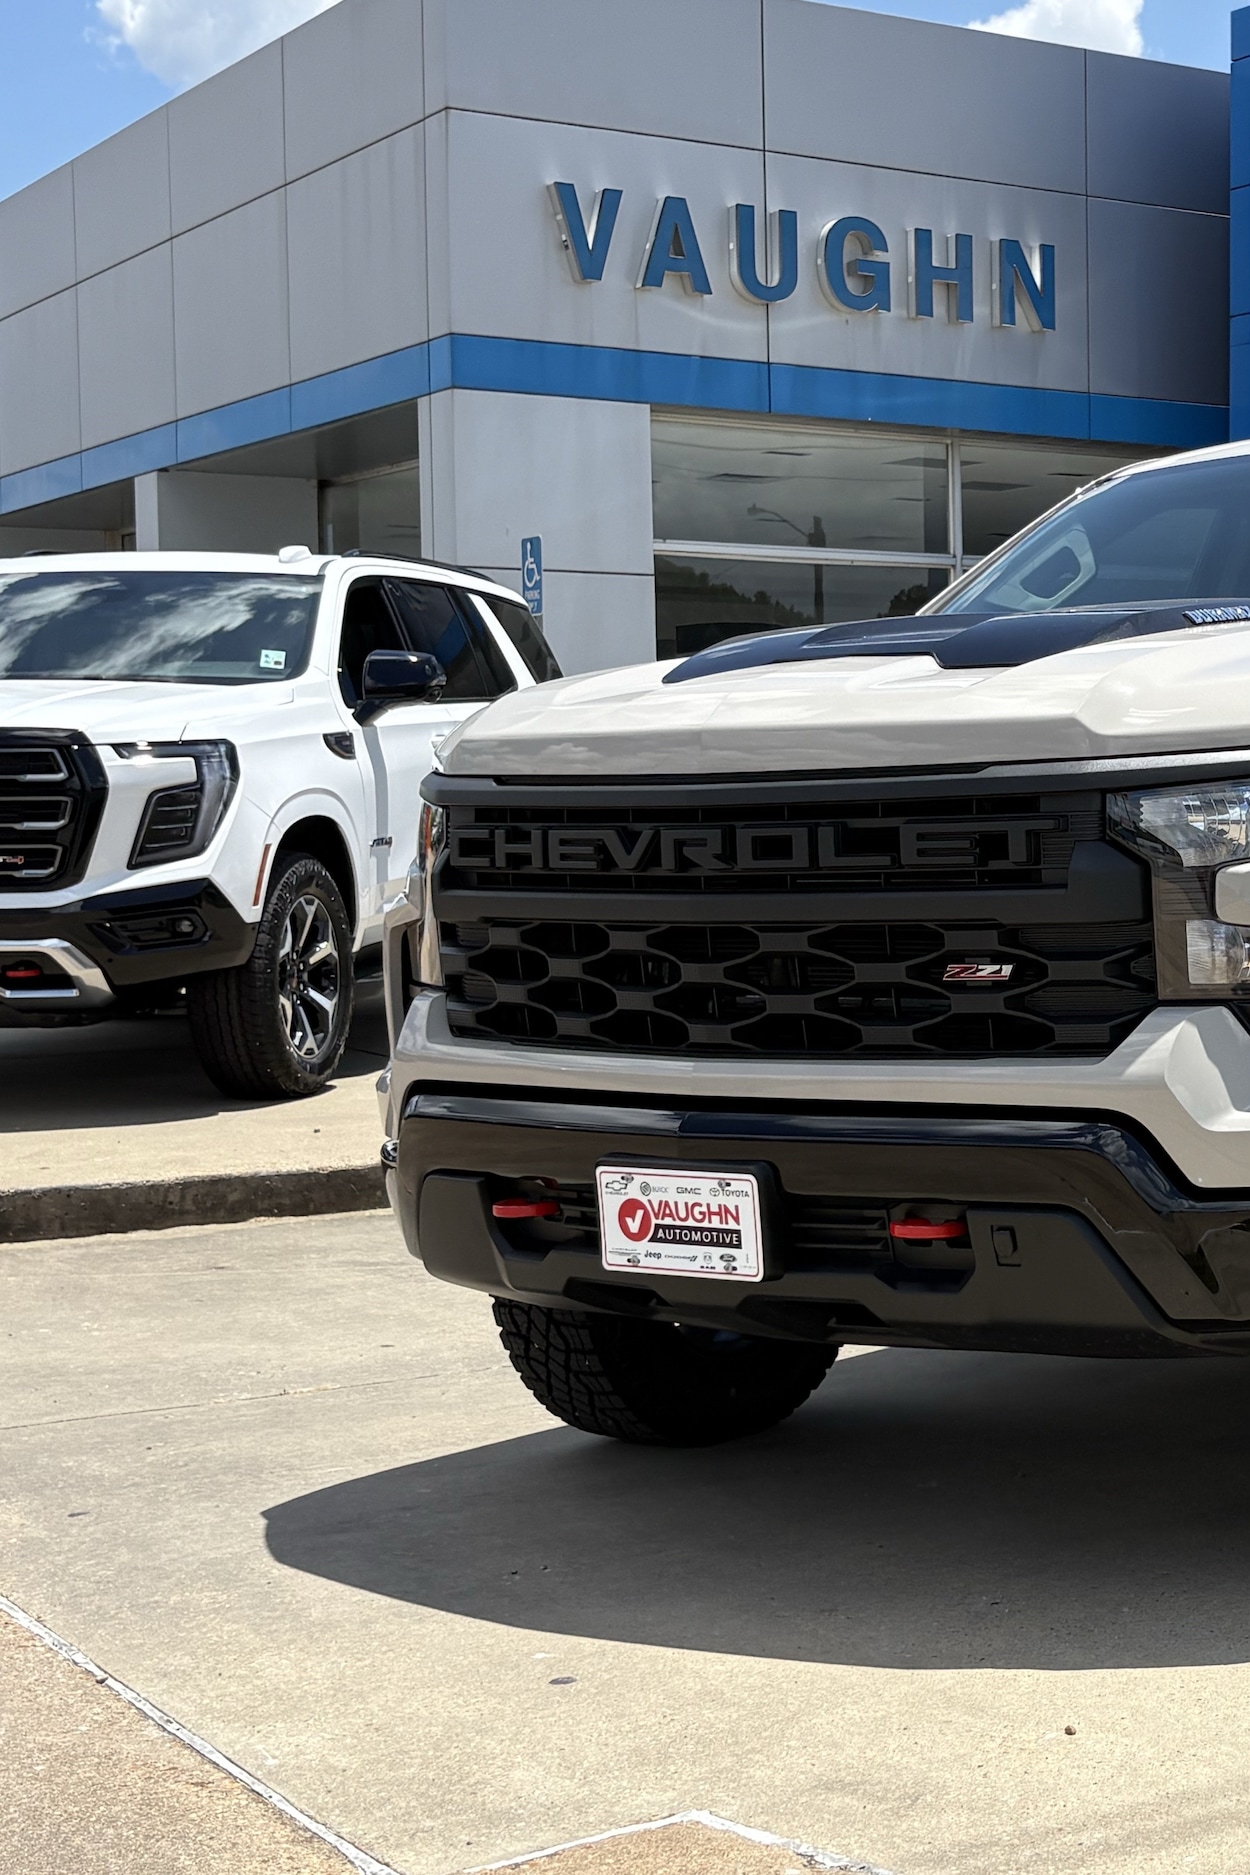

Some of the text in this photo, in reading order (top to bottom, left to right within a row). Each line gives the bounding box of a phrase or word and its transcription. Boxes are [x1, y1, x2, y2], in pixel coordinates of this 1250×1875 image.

[547, 182, 1057, 332] VAUGHN
[448, 818, 1066, 872] CHEVROLET
[676, 1186, 702, 1196] GMC
[721, 1189, 750, 1198] TOYOTA
[647, 1199, 741, 1226] VAUGHN
[656, 1229, 740, 1246] AUTOMOTIVE
[644, 1250, 663, 1260] Jeep
